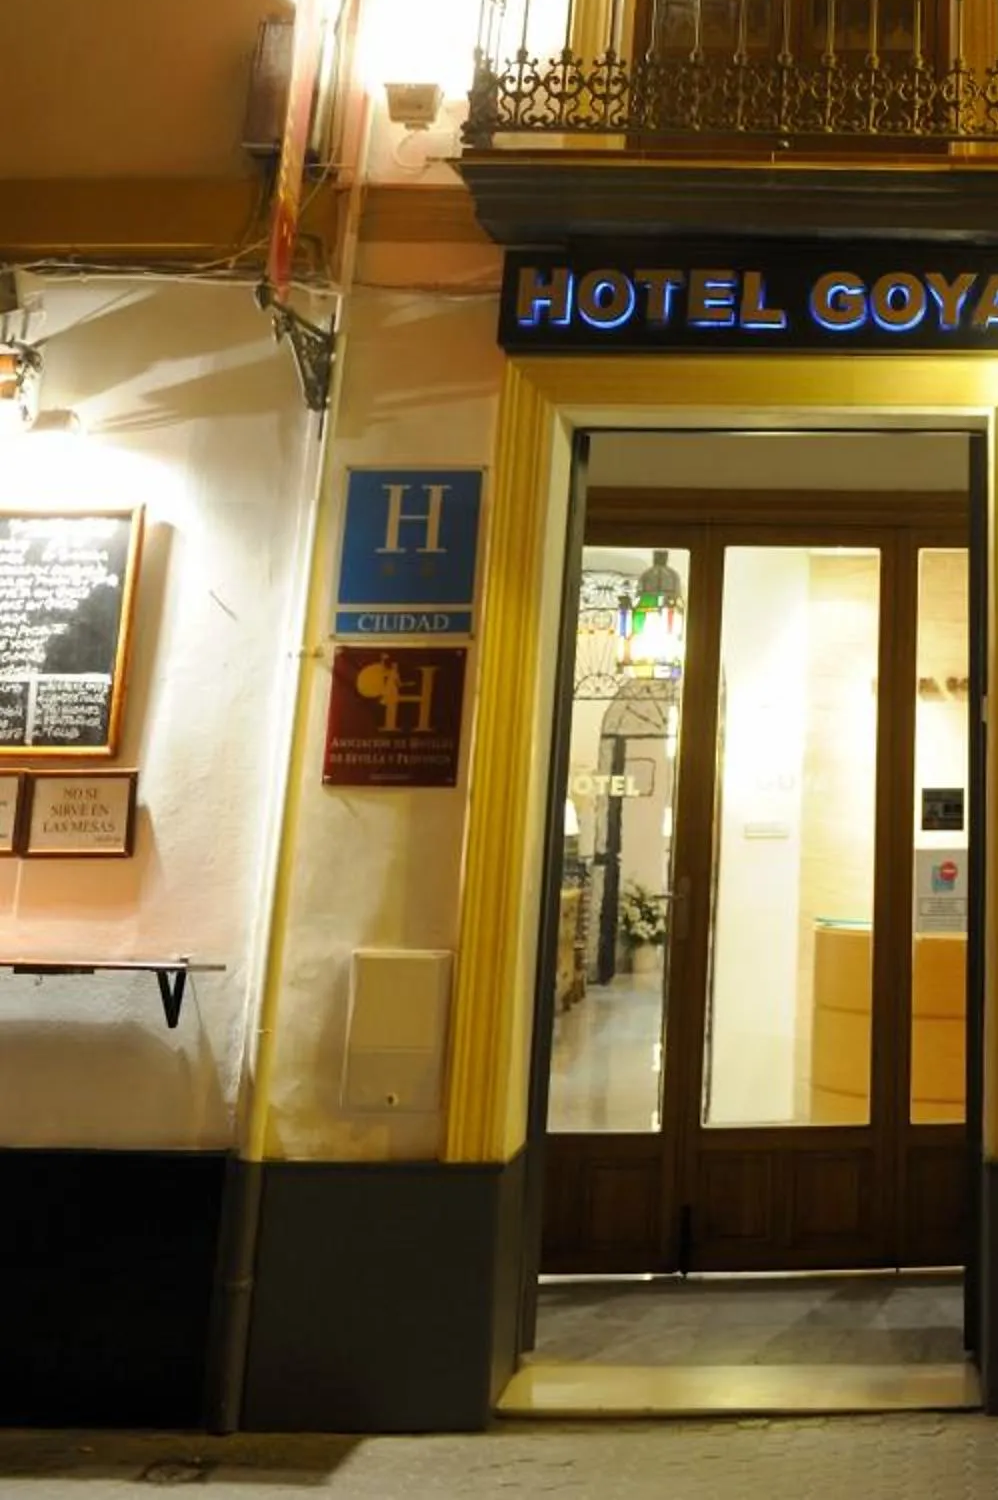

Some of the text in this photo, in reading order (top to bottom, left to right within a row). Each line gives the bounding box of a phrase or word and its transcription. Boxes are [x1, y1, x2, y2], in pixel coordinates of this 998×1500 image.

[517, 266, 787, 329] HOTEL
[374, 483, 452, 554] H
[357, 613, 449, 632] CIUDAD
[572, 775, 641, 798] OTEL
